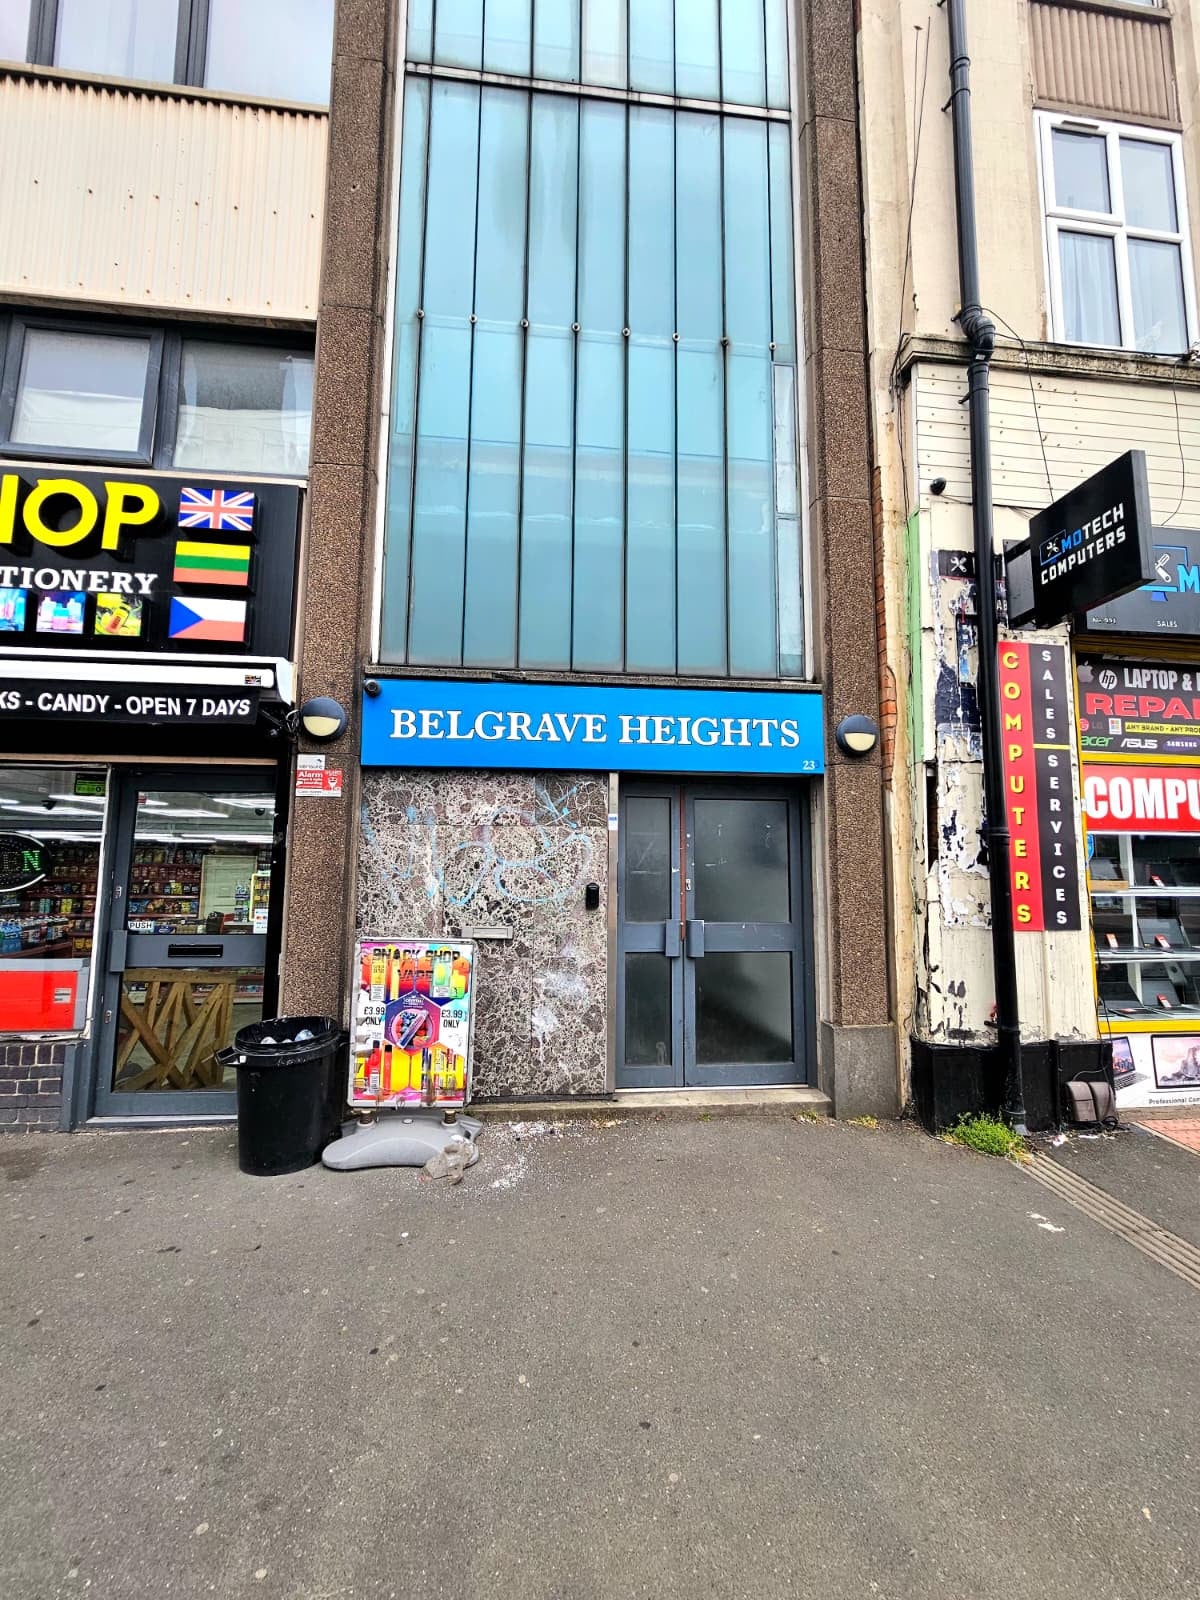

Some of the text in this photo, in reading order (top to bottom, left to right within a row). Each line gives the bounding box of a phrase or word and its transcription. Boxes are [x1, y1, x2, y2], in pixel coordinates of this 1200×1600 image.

[1061, 502, 1124, 553] MOTECH
[1041, 525, 1126, 585] COMPUTERS
[0, 566, 158, 595] TIONERY
[1123, 667, 1178, 690] LAPTOP
[1182, 673, 1193, 691] &
[37, 692, 110, 713] CANDY
[126, 696, 181, 716] OPEN
[186, 698, 197, 716] 7
[202, 698, 251, 716] DAYS
[1042, 650, 1057, 739] SALES
[390, 708, 800, 748] BELGRAVE HEIGHTS
[1080, 736, 1113, 747] acer
[1121, 738, 1158, 748] ASUS
[1002, 651, 1031, 924] COMPUTERS
[1047, 755, 1068, 925] SERVICES
[364, 1006, 386, 1016] £3.99
[365, 1016, 382, 1026] ONLY
[441, 1009, 463, 1019] £3.99
[443, 1018, 460, 1028] ONLY
